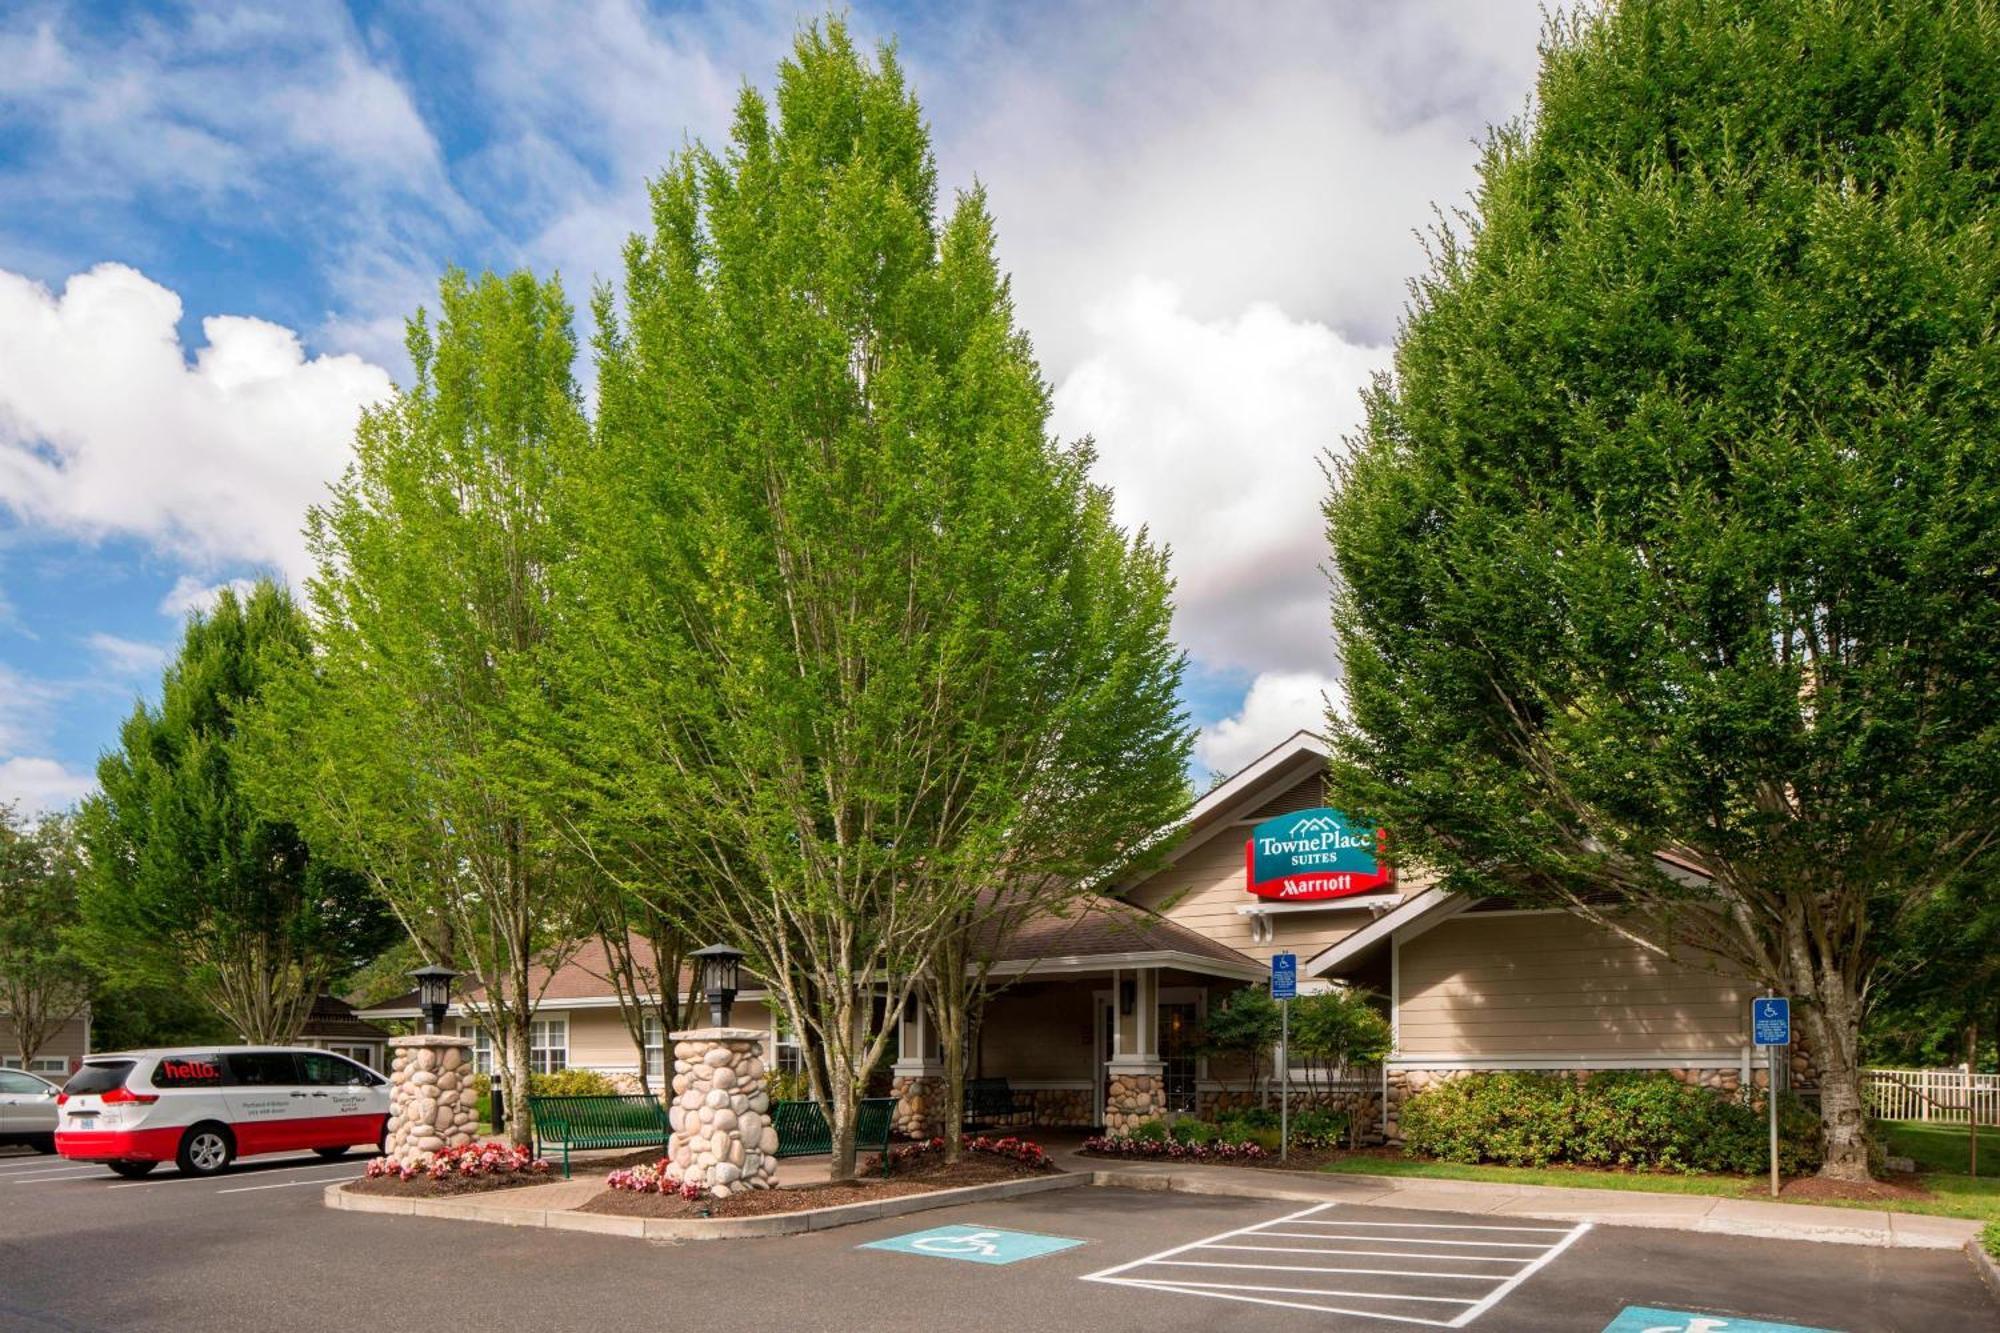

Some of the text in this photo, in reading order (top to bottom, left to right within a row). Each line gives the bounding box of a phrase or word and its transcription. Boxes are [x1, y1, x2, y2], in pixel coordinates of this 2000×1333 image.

[1291, 852, 1337, 866] SUITES
[1280, 875, 1351, 897] Marriott
[163, 1060, 220, 1079] hello.
